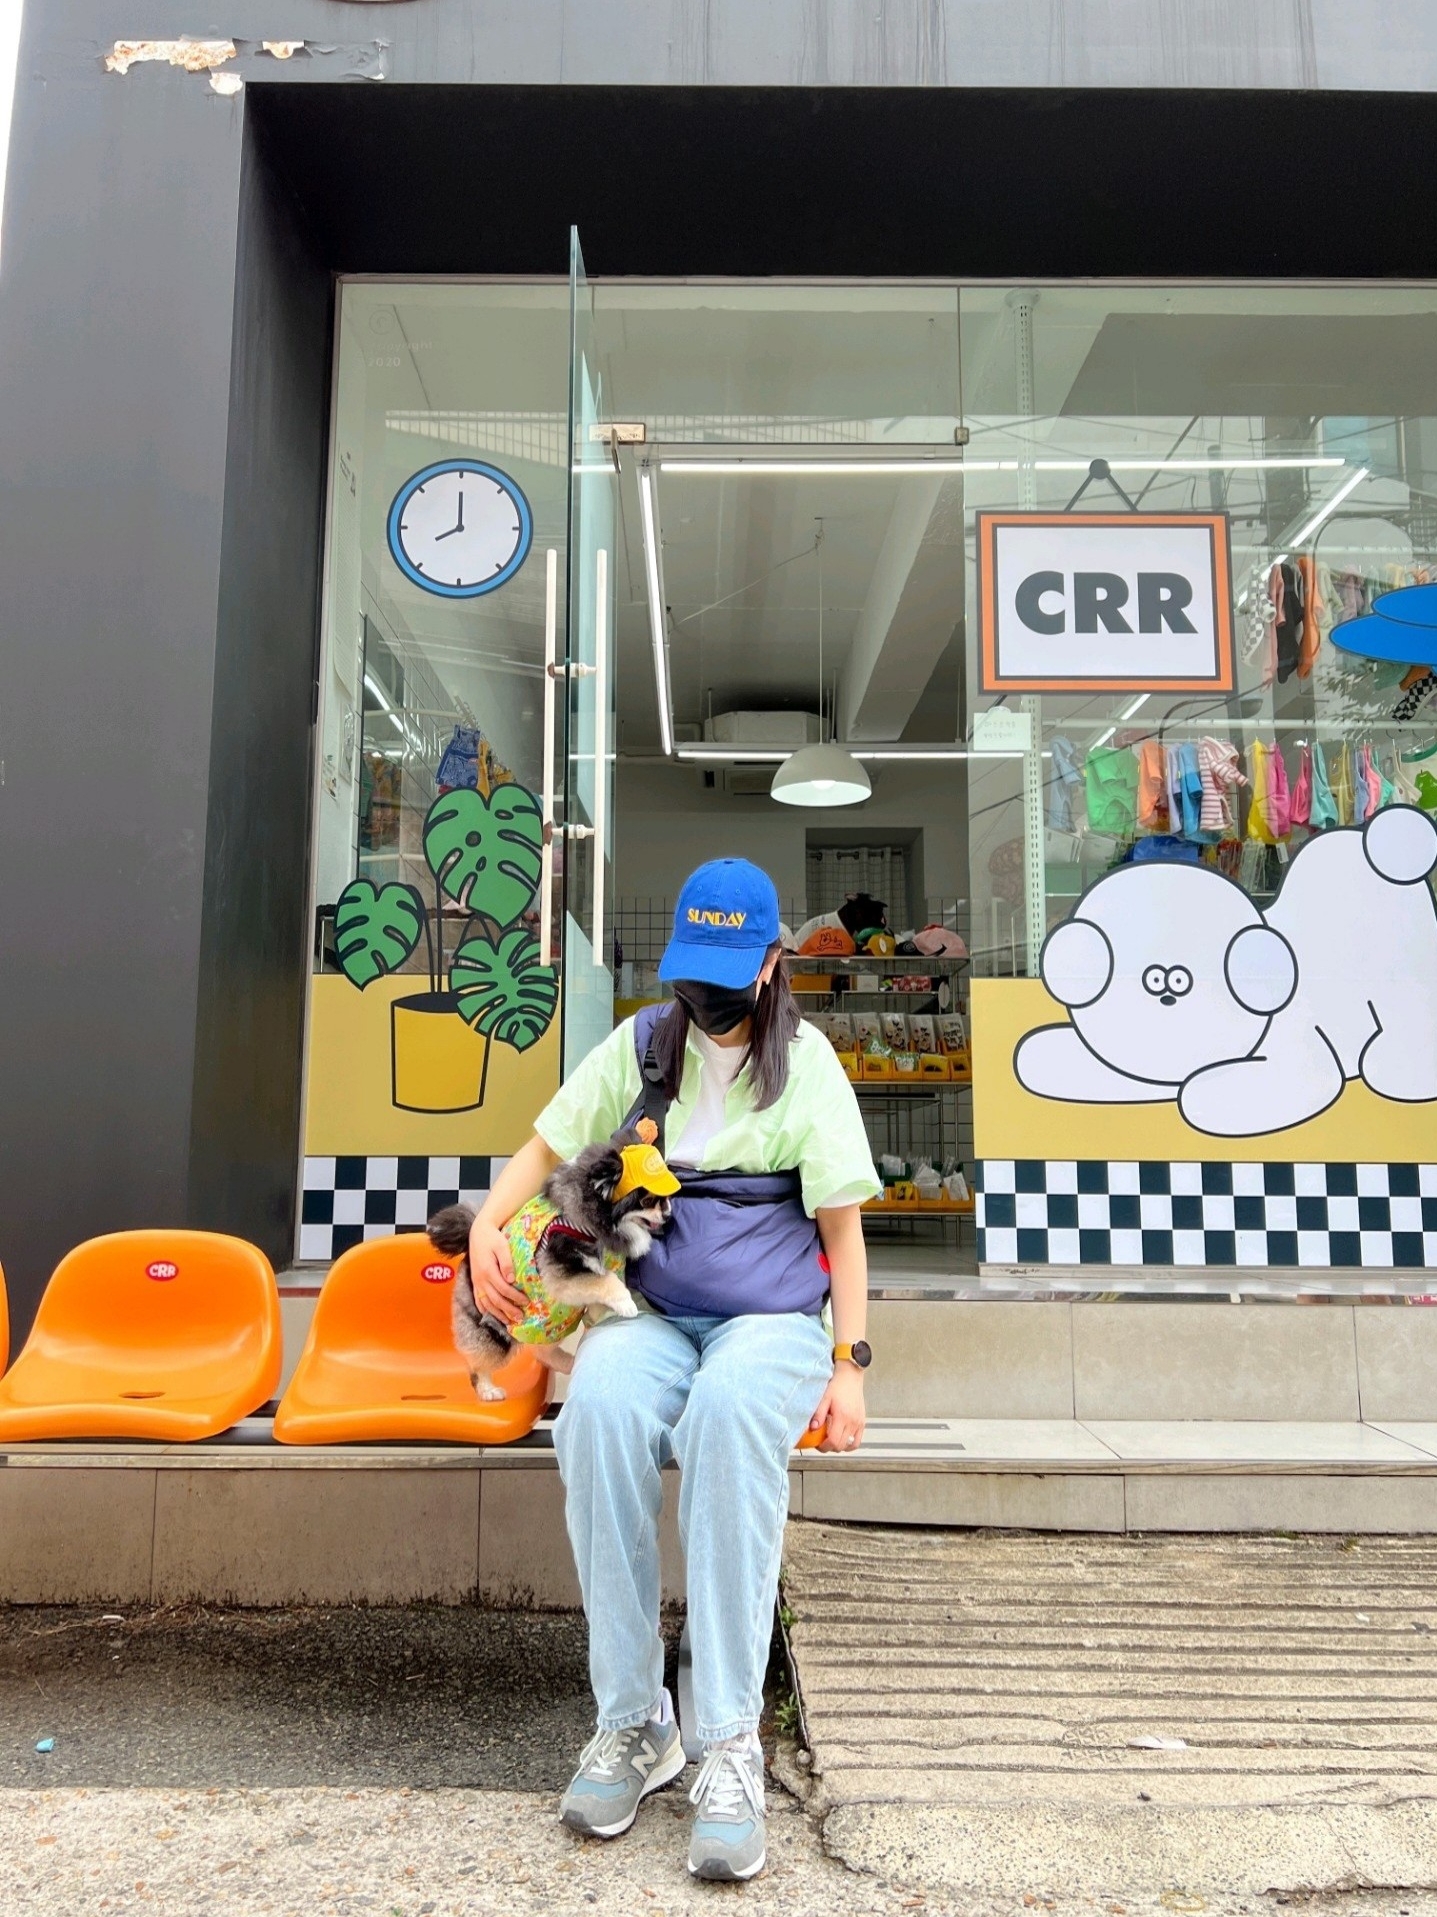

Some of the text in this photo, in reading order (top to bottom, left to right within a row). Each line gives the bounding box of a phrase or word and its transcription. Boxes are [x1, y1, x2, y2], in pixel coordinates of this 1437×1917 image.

[369, 340, 433, 353] opyright
[367, 356, 401, 367] 2020
[1015, 570, 1198, 635] CRR
[687, 908, 746, 930] SUNDAY
[149, 1263, 177, 1278] CRR
[424, 1266, 452, 1280] CRR
